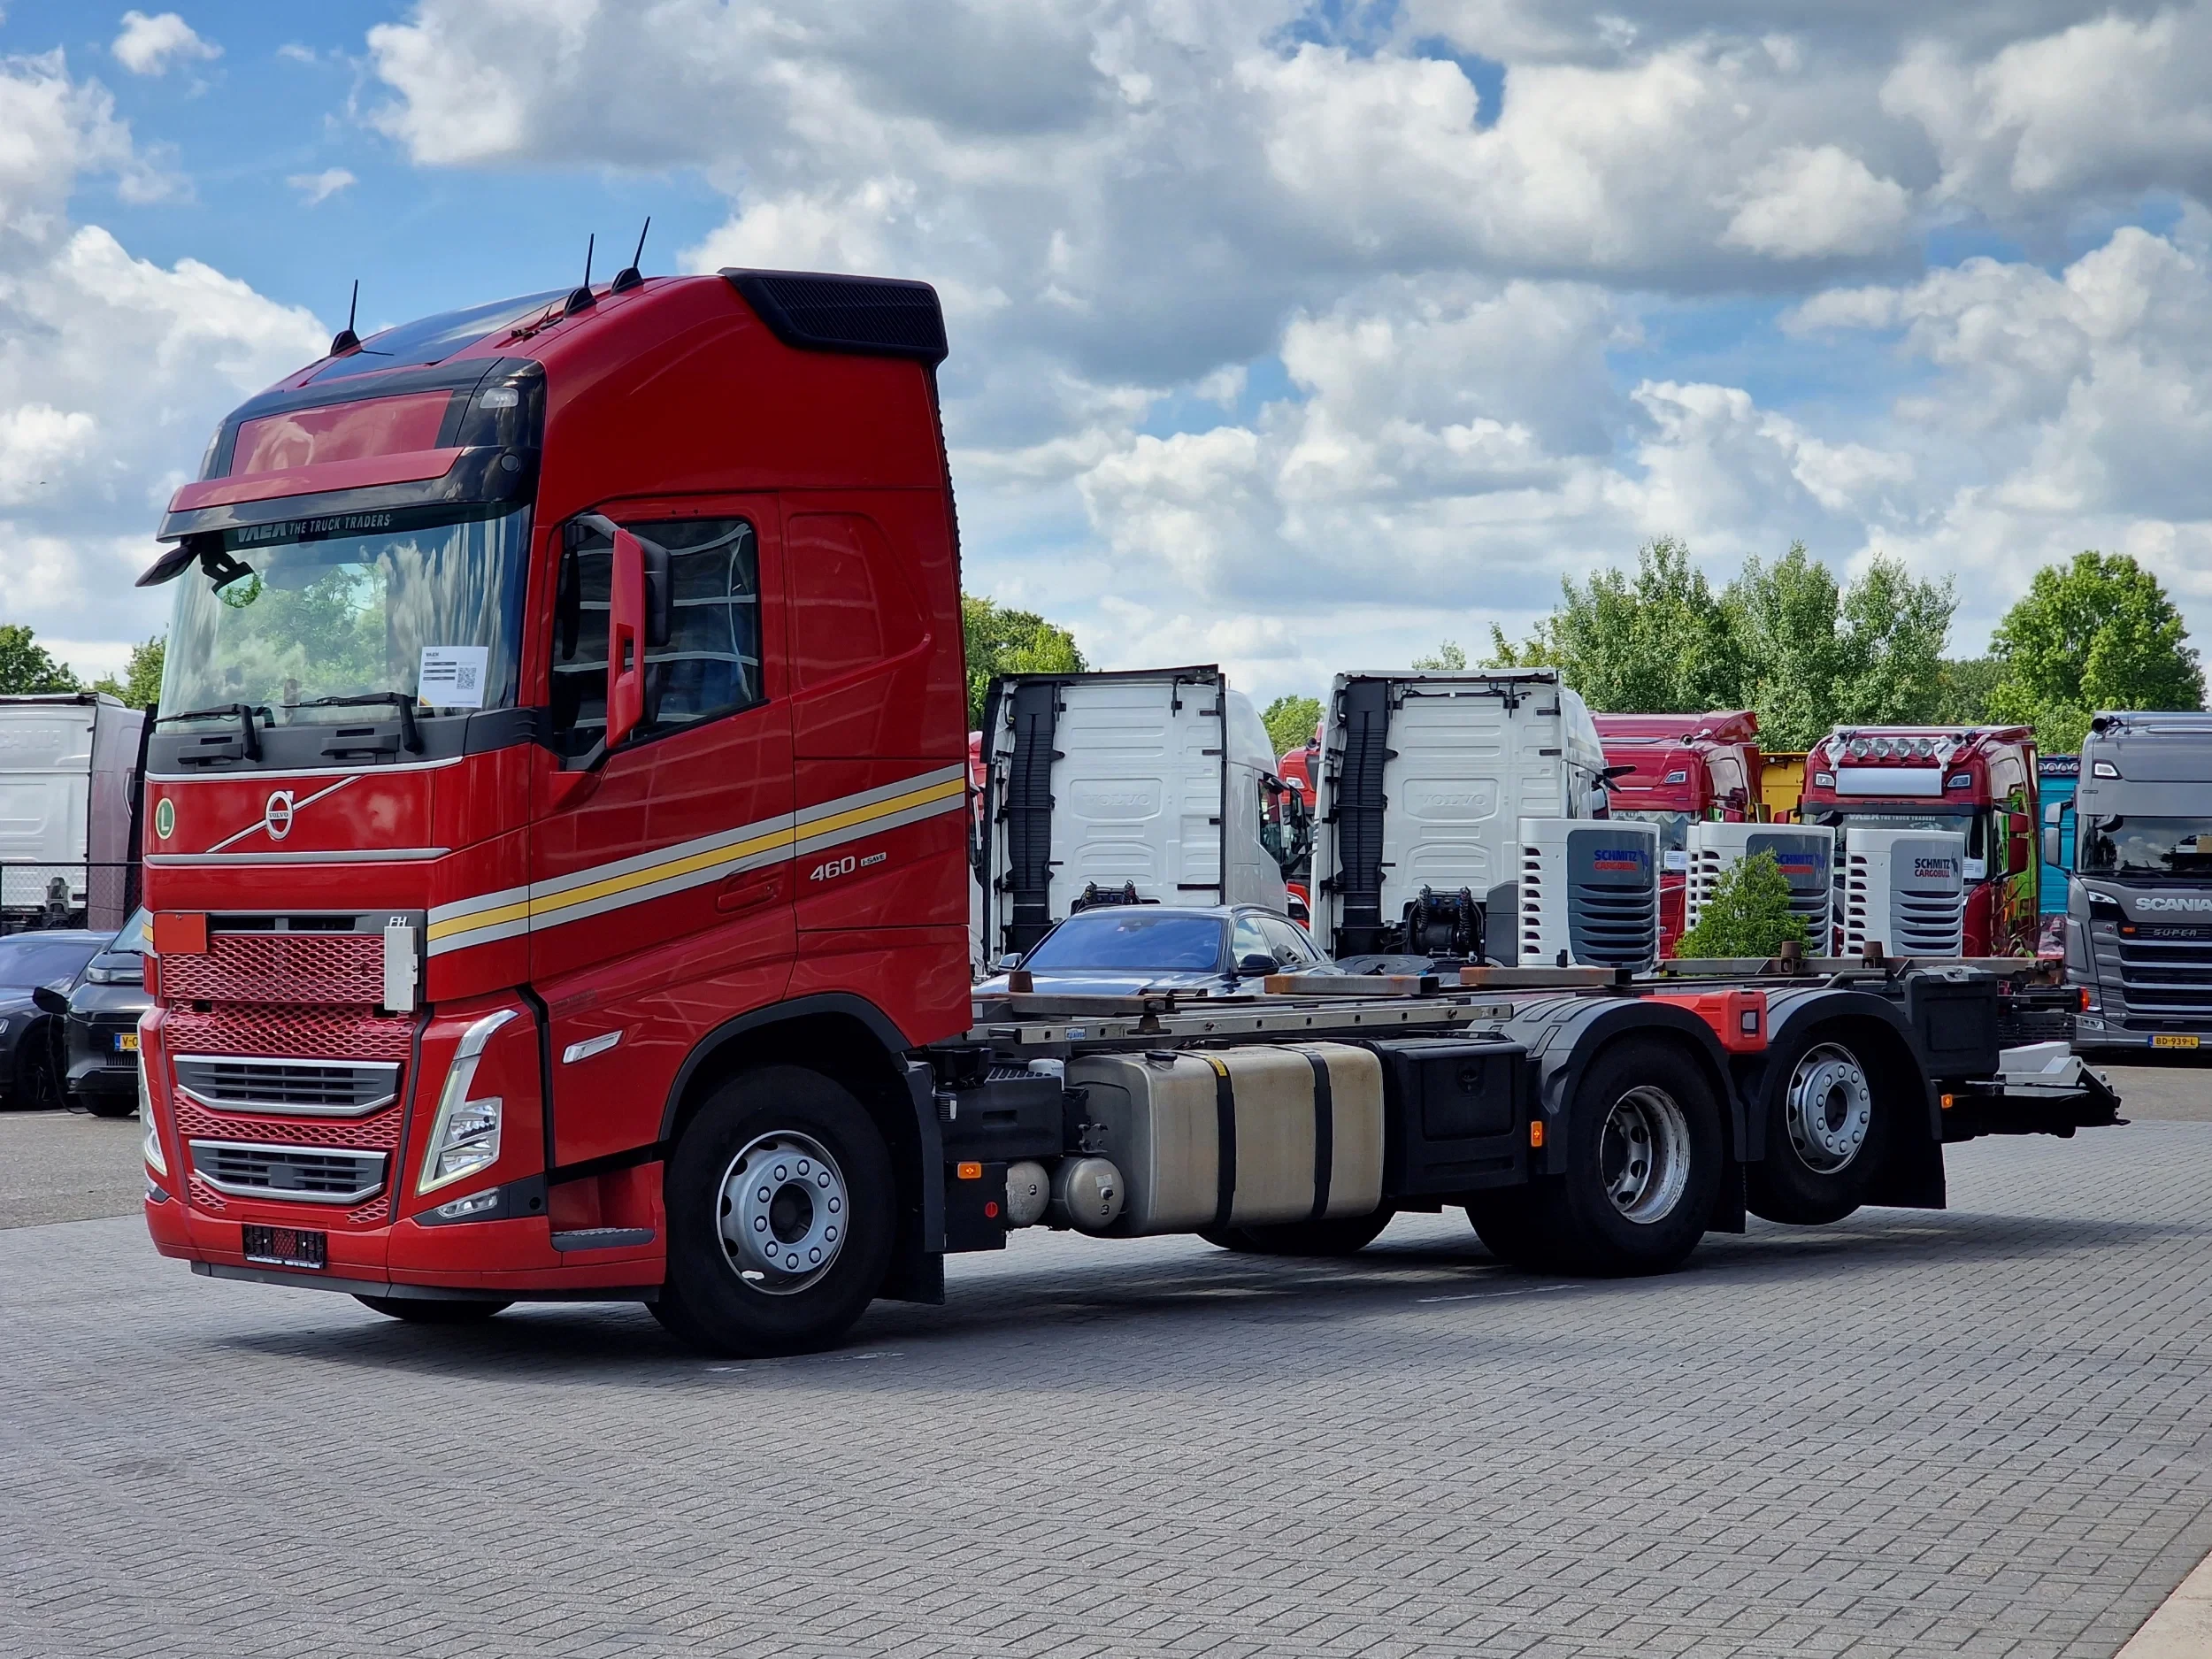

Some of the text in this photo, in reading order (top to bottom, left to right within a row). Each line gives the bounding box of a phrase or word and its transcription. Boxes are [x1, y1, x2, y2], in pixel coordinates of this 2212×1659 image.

[289, 522, 307, 534] THE
[310, 518, 340, 533] TRUCK
[345, 514, 390, 529] TRADERS
[160, 807, 170, 832] L
[1594, 849, 1638, 862] SCHMITZ
[810, 853, 886, 881] 460 I-SAVE
[1915, 858, 1950, 869] SCHMITZ
[1915, 869, 1950, 878] CARGOBULL
[2153, 928, 2197, 937] SUPER
[2155, 1037, 2196, 1046] BD-939-L
